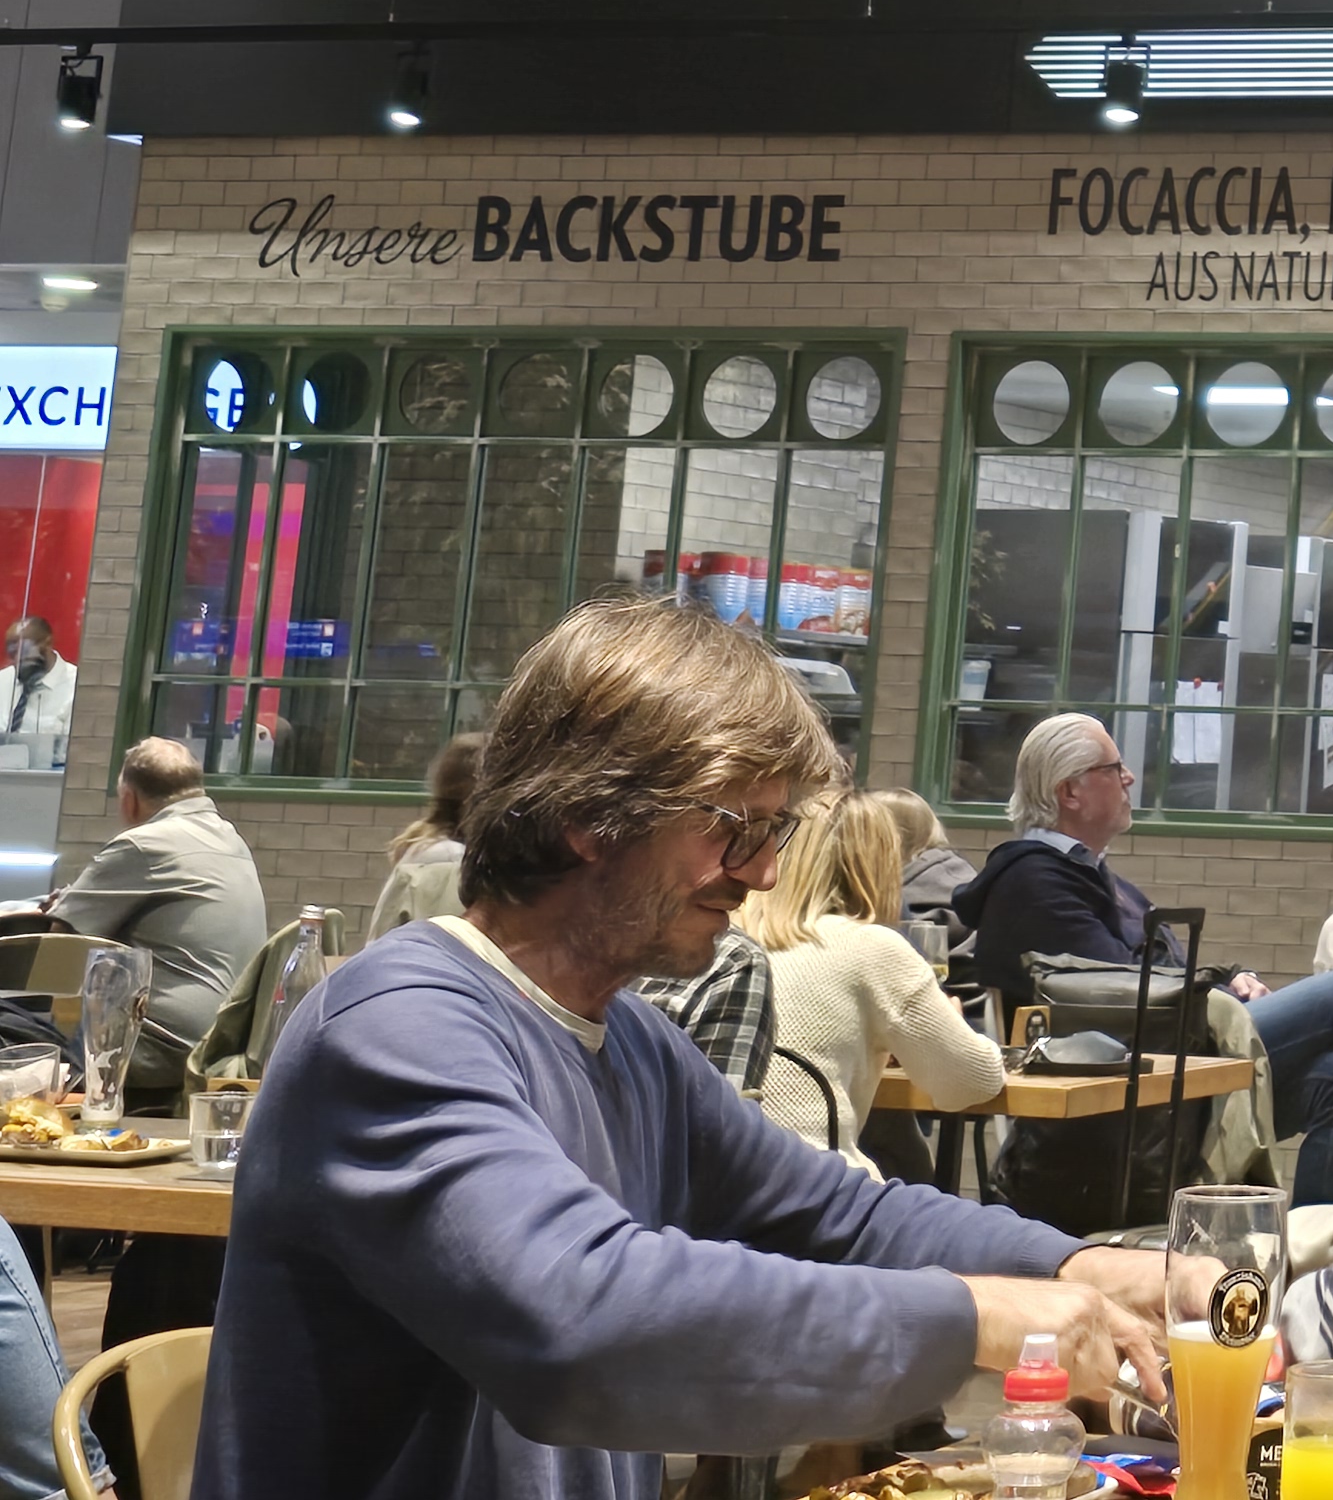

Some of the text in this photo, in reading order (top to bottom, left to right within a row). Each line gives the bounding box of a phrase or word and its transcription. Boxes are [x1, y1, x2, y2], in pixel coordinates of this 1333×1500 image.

[249, 194, 846, 277] Unsere BACKSTUBE
[1047, 166, 1311, 244] FOCACCIA,
[1146, 252, 1219, 302] AUS
[0, 386, 107, 426] XCH
